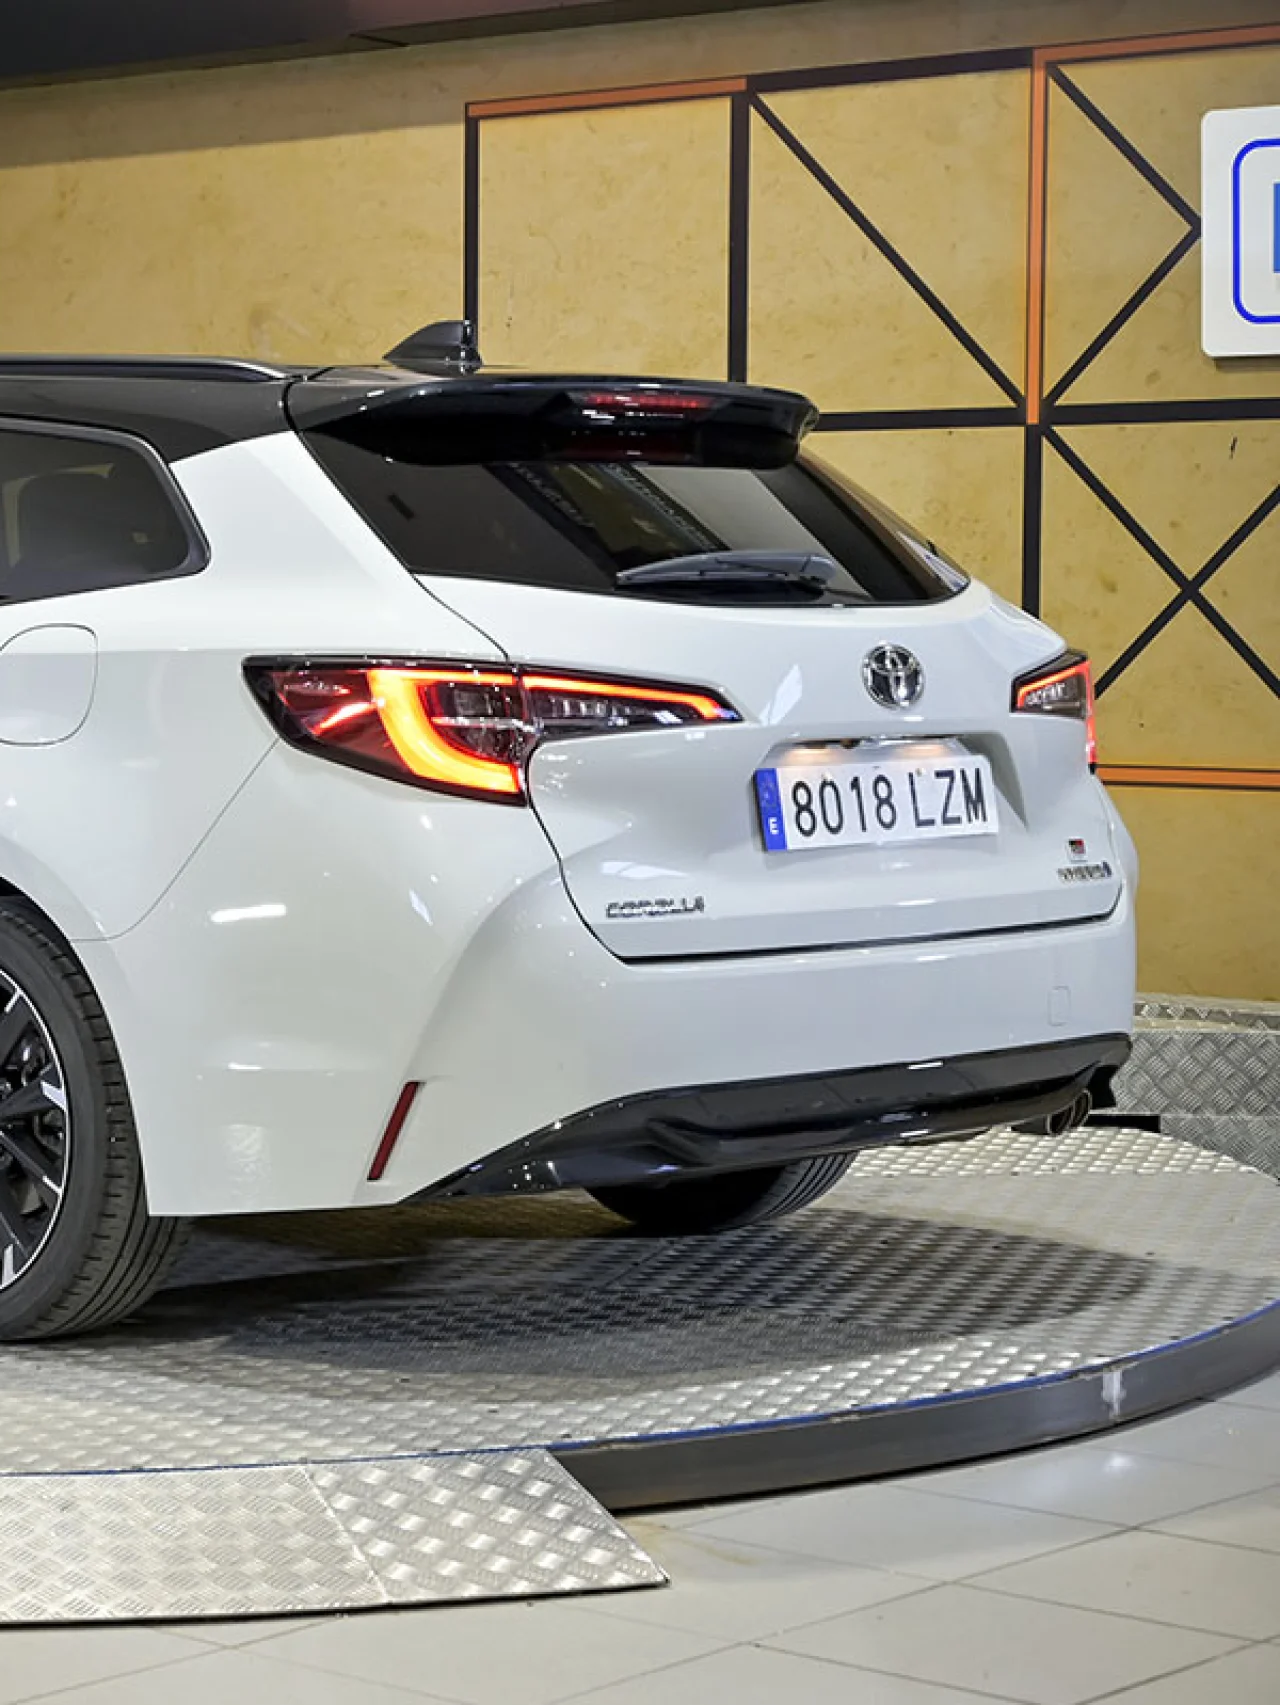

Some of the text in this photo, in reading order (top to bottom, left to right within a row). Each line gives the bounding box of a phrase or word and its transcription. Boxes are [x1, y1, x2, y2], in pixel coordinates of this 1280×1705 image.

[768, 767, 987, 837] E 8018 LZM
